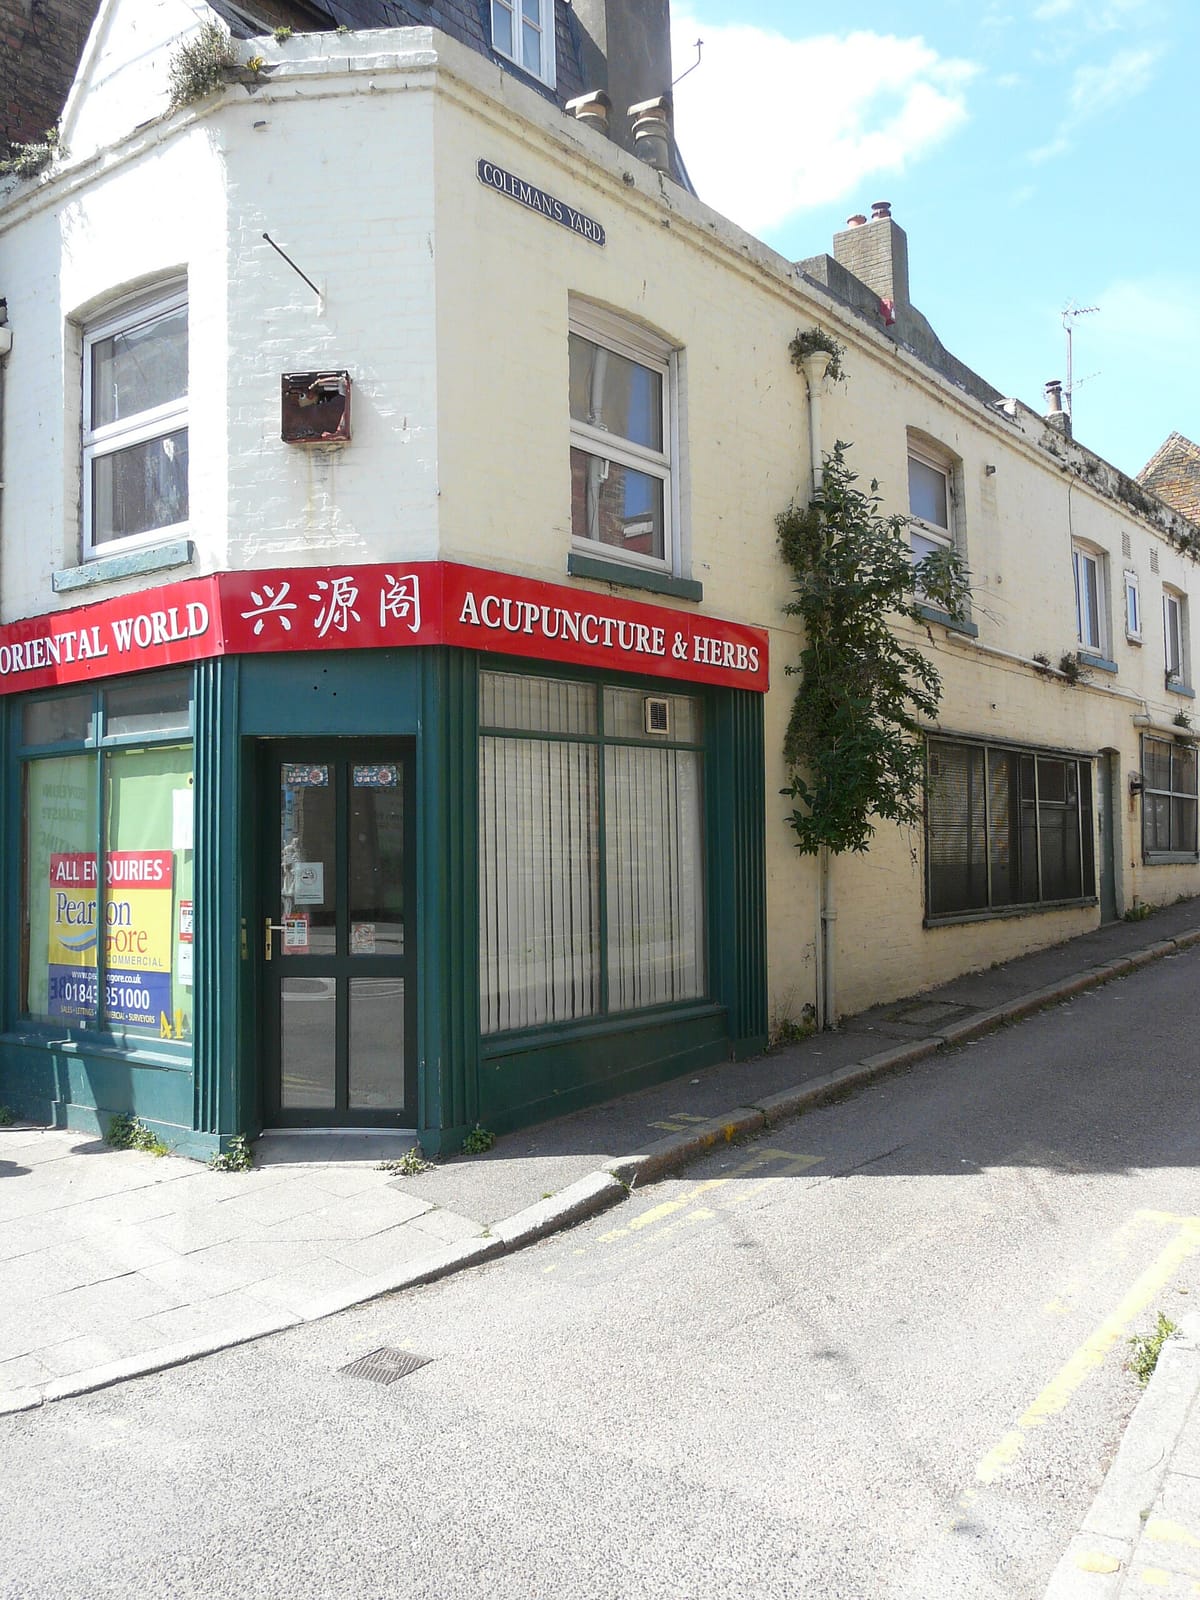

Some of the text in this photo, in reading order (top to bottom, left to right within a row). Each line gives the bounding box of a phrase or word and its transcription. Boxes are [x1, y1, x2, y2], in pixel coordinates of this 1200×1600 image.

[484, 163, 601, 241] COLEMAN'S YARD
[0, 602, 209, 675] ORIENTAL WORLD
[240, 574, 421, 638] 兴源阁
[459, 591, 759, 673] ACUPUNCTURE & HERBS
[55, 861, 80, 881] ALL
[55, 892, 132, 926] Pearon
